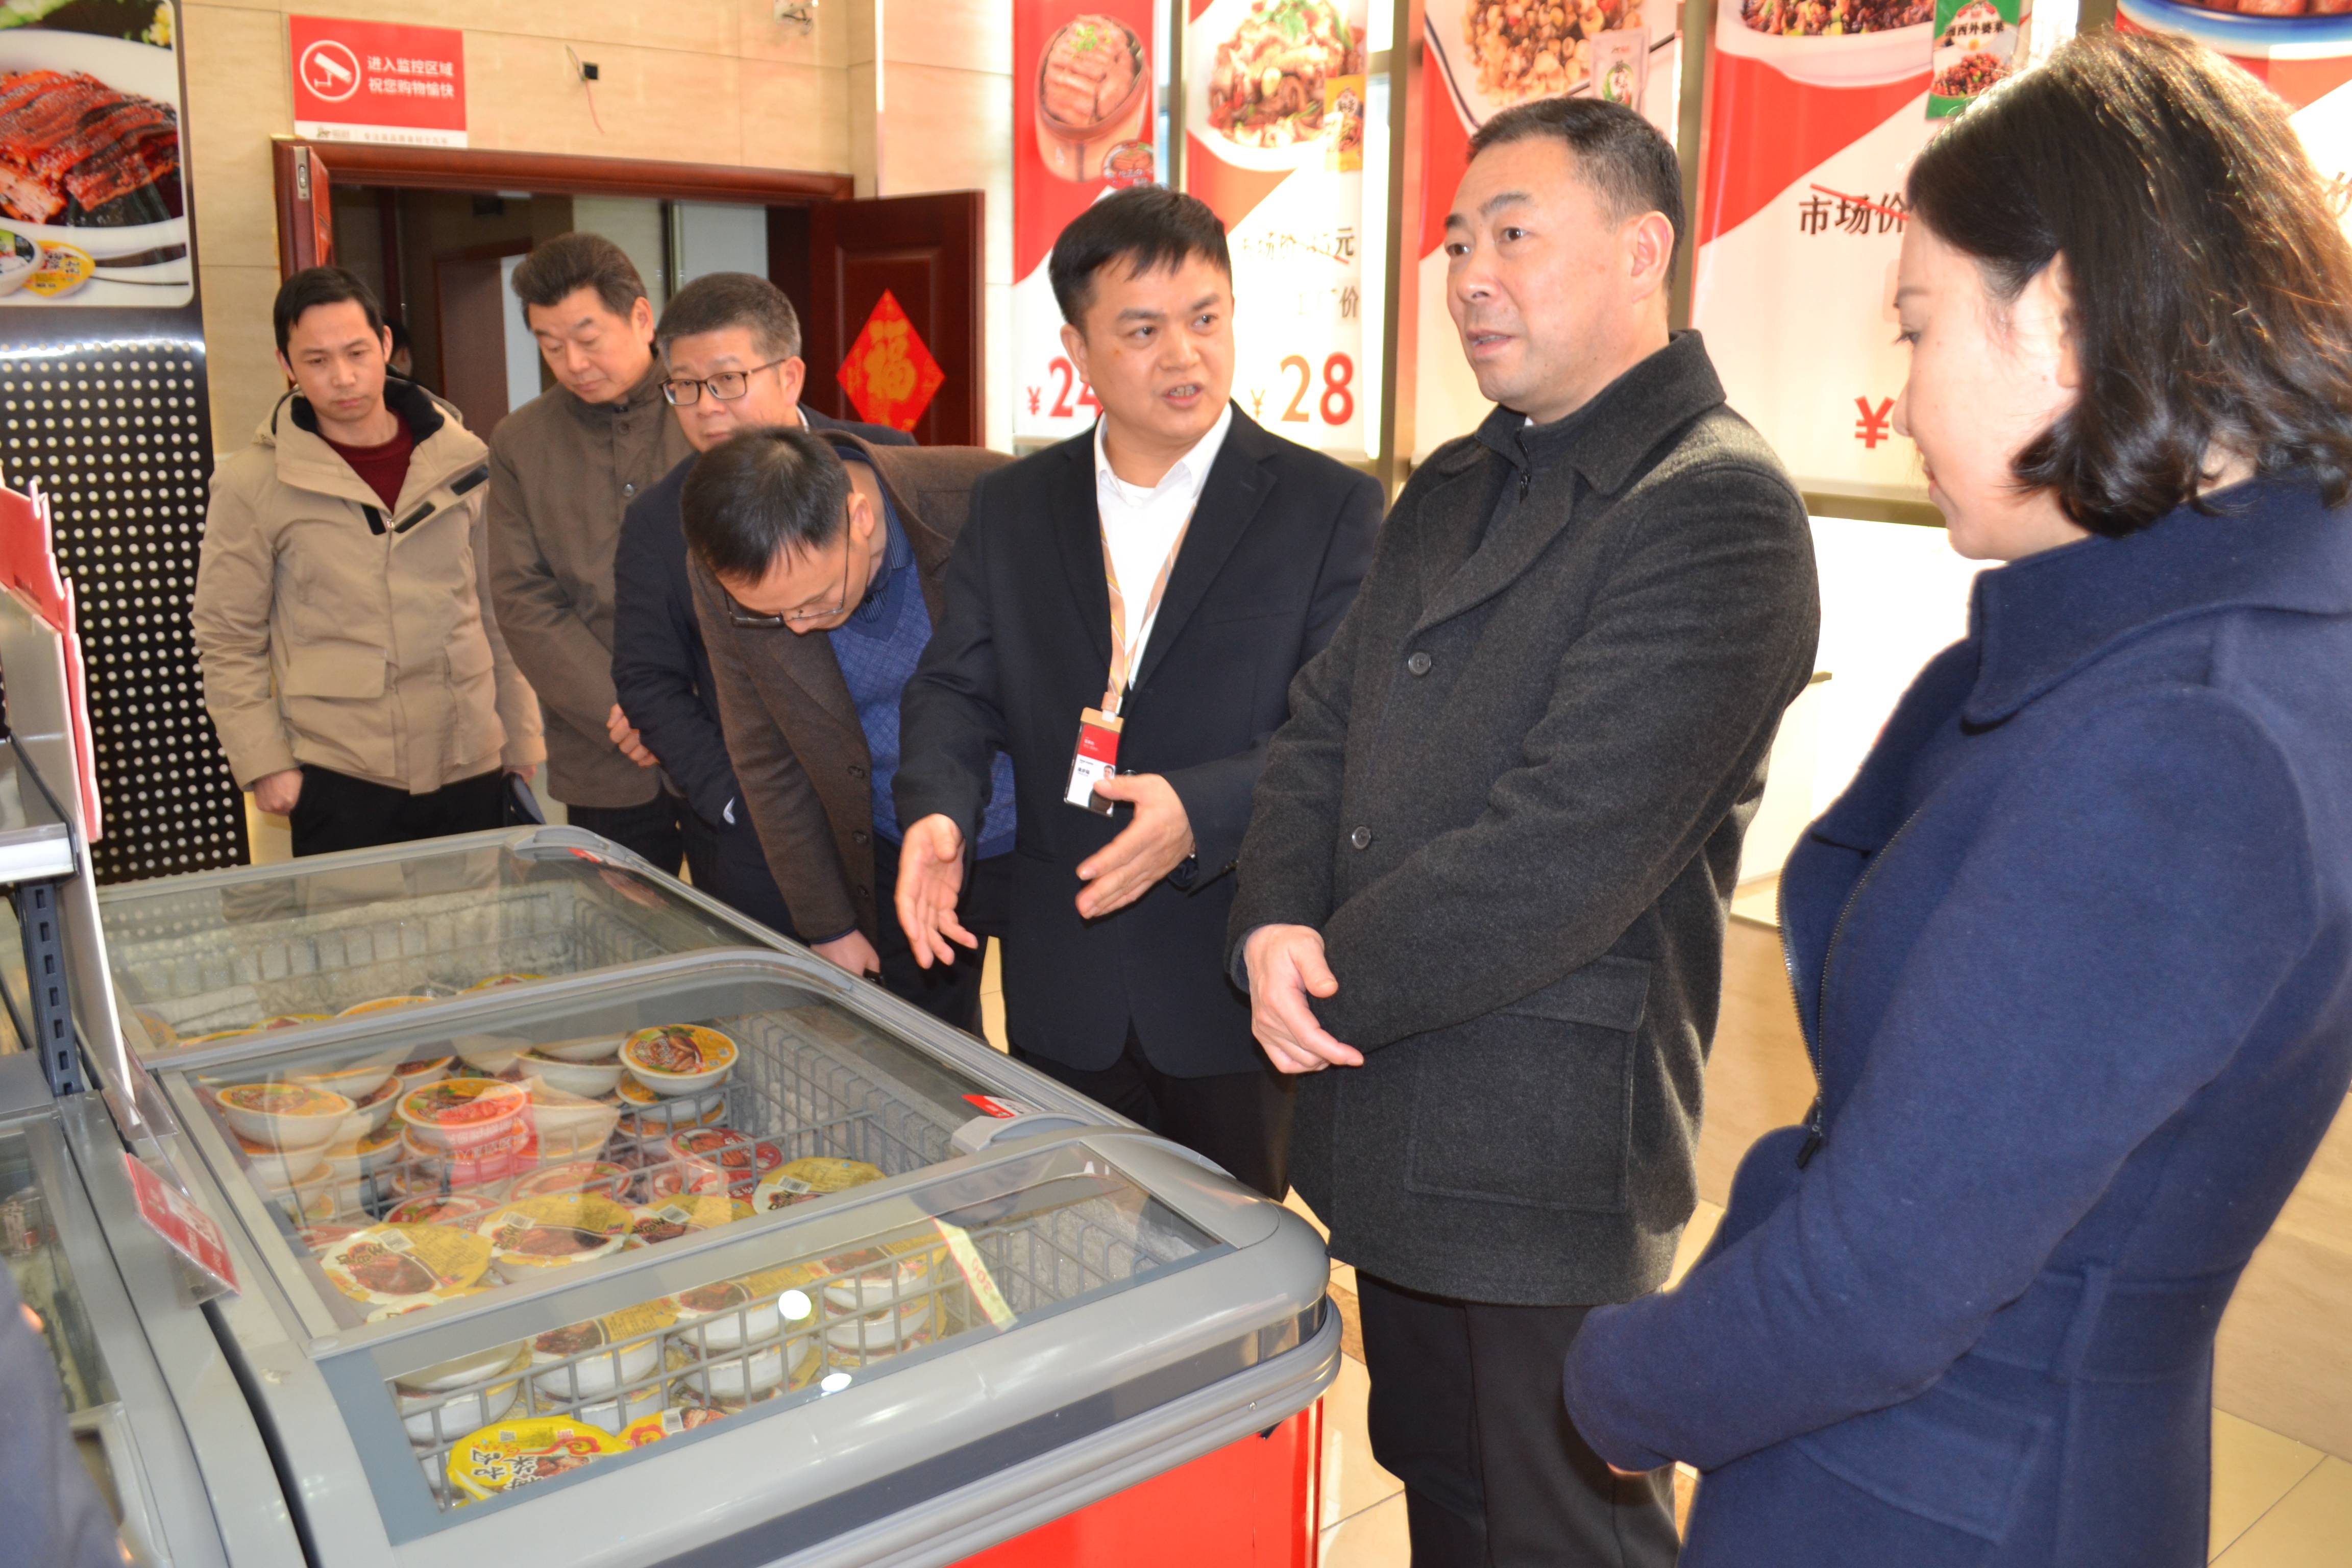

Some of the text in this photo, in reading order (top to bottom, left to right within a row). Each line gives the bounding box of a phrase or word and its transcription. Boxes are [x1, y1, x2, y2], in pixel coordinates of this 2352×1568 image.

[368, 56, 453, 77] 进入监控区域
[369, 78, 454, 99] 祝您购物愉快
